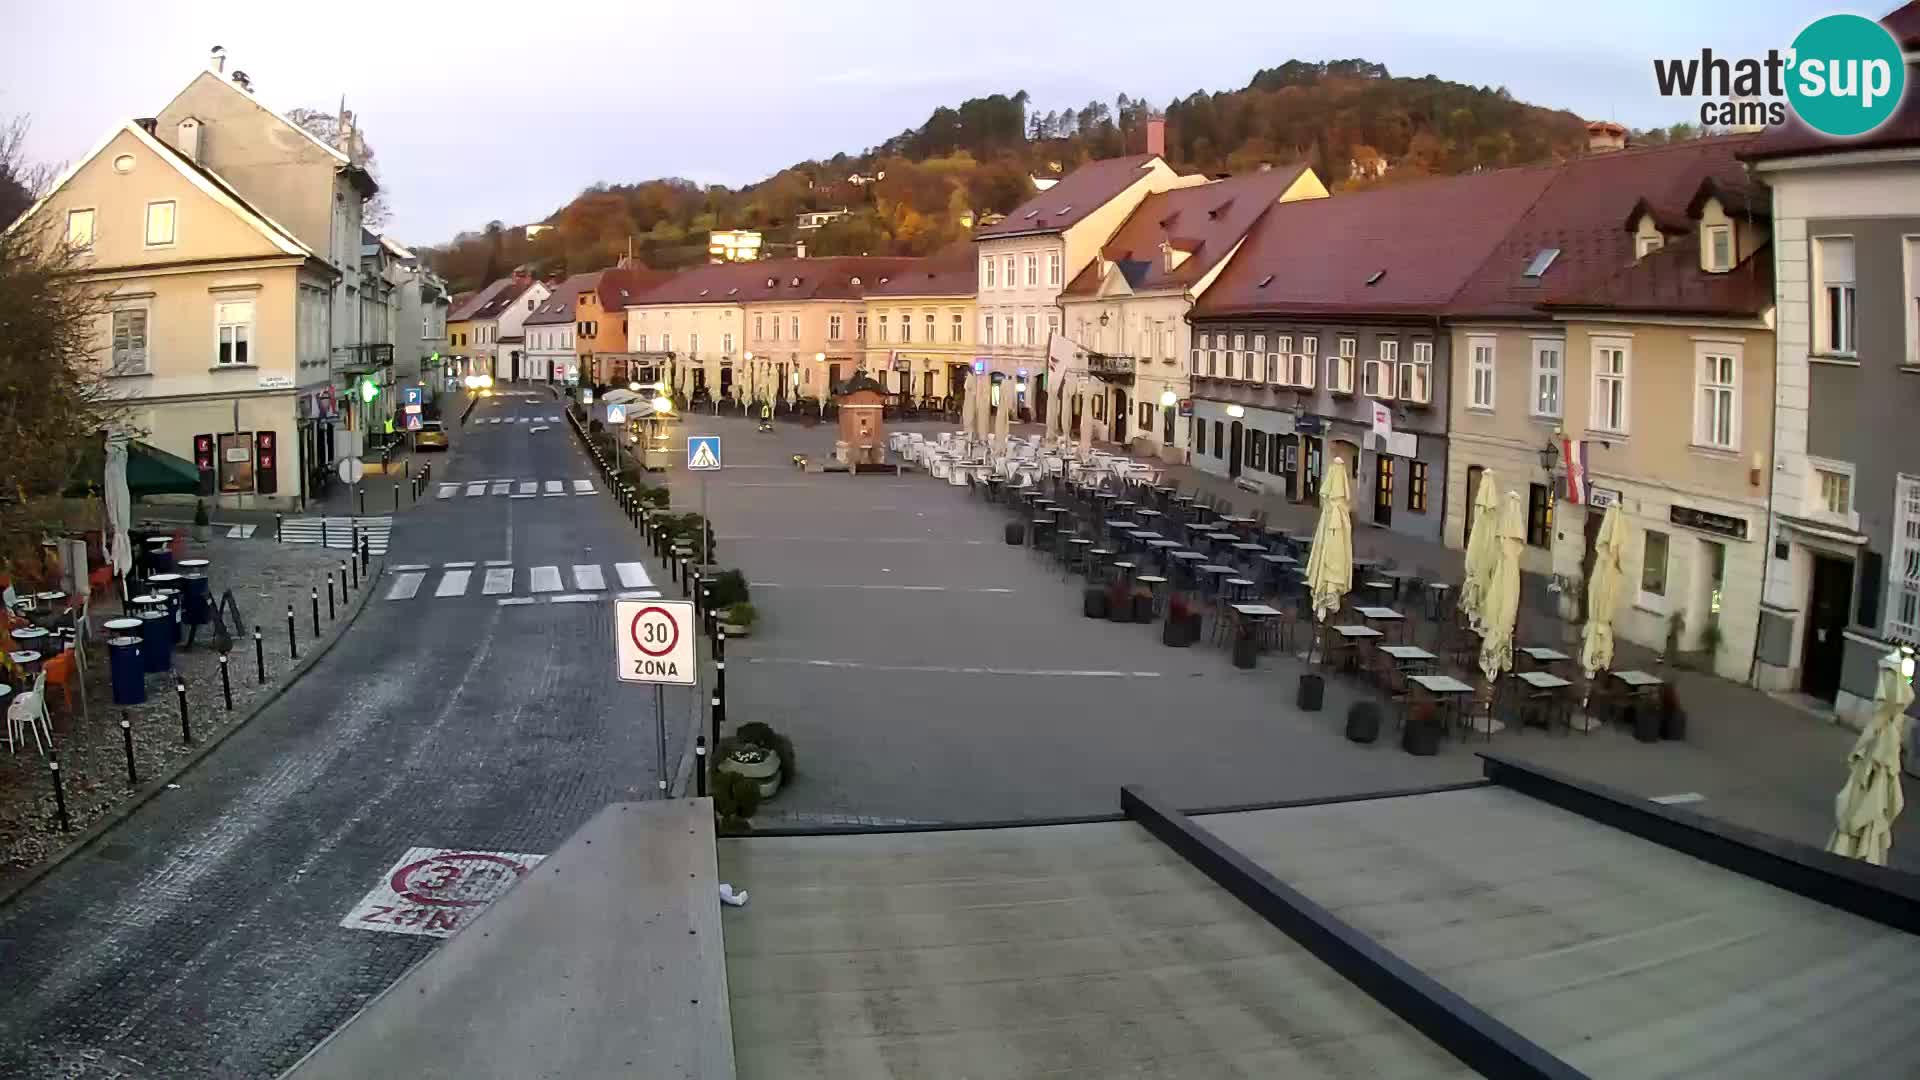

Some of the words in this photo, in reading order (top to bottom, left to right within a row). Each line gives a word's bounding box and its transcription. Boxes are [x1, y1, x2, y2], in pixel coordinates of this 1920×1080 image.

[409, 391, 417, 402] P
[644, 622, 668, 643] 30
[634, 660, 679, 676] ZONA
